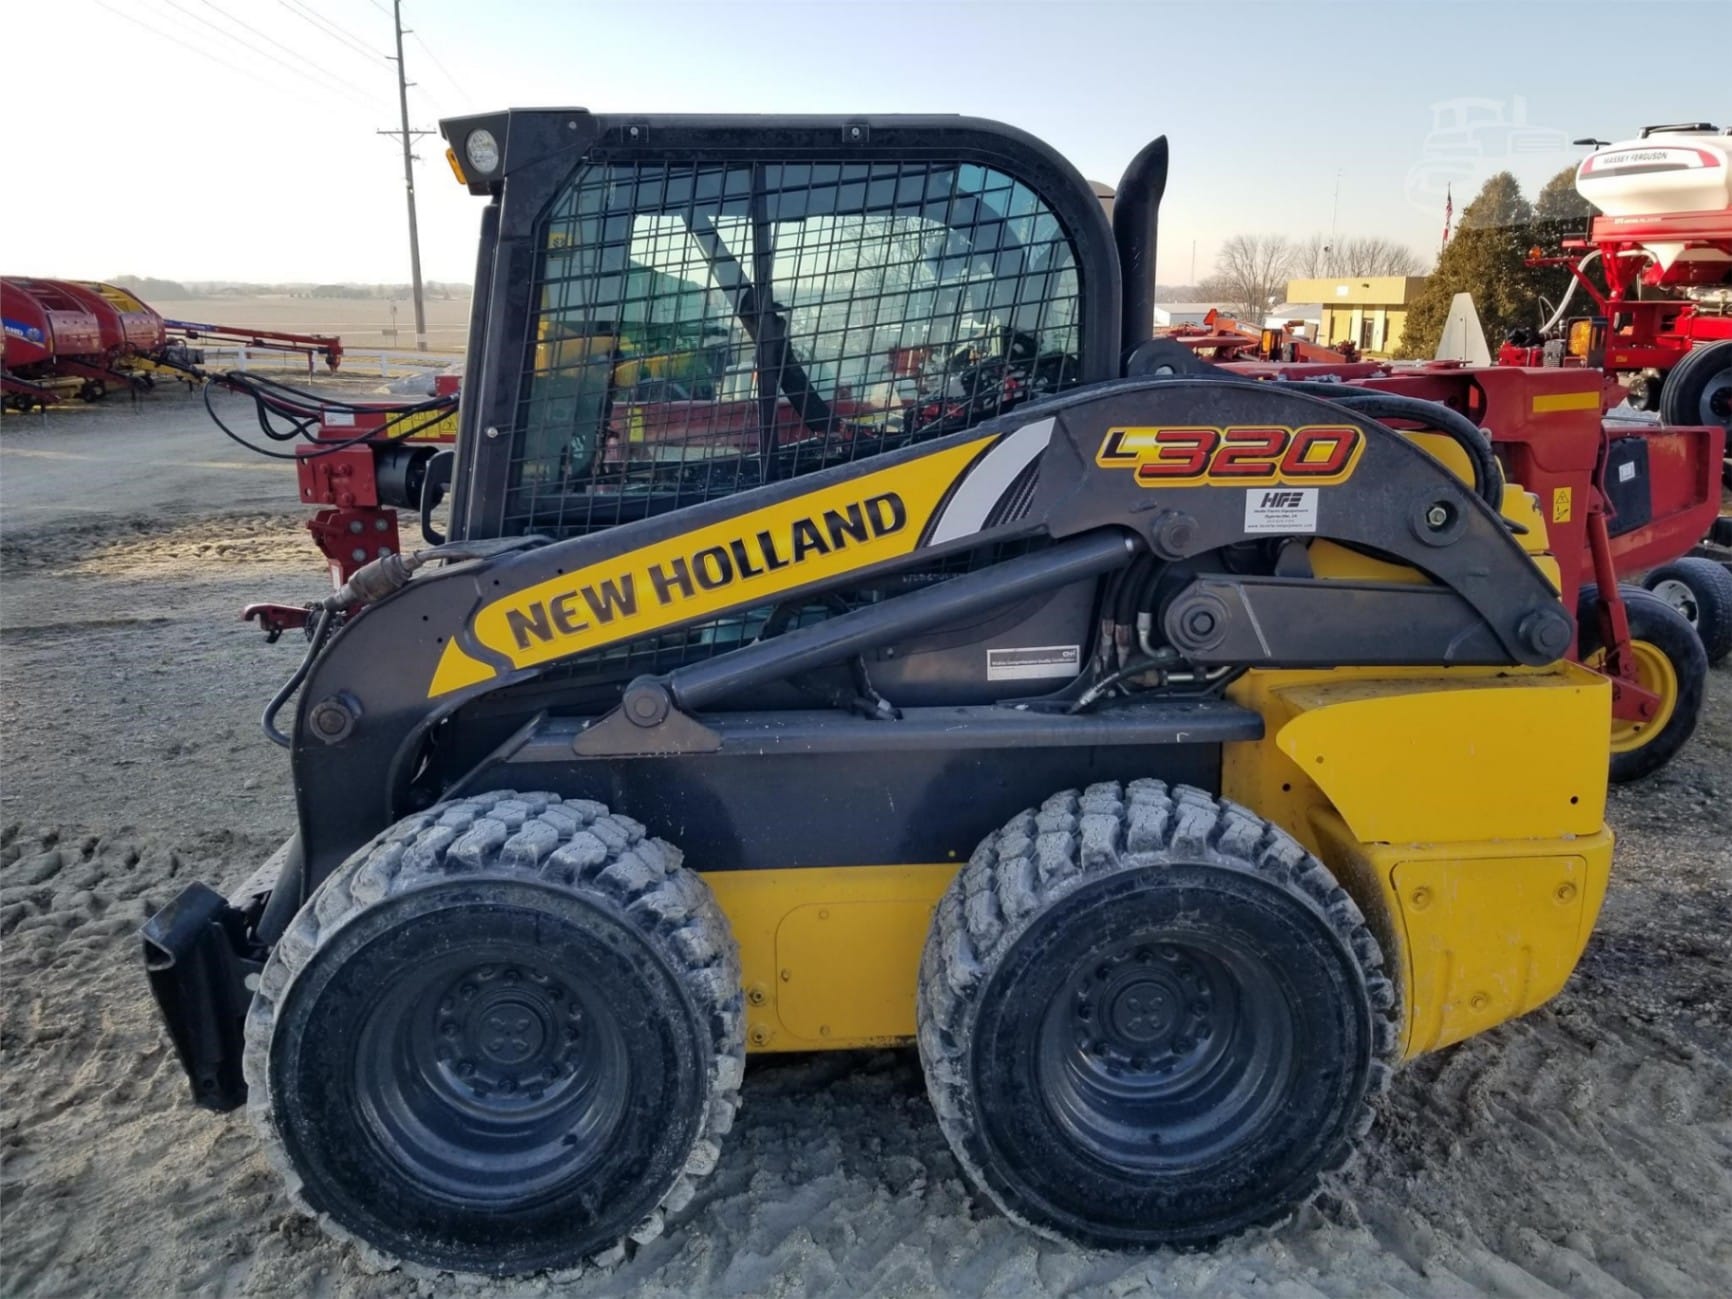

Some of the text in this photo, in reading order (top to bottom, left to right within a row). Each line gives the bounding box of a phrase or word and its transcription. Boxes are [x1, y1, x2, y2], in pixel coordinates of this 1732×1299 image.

[1100, 427, 1362, 479] L320
[1260, 492, 1304, 508] HFE
[505, 491, 908, 652] NEW HOLLAND
